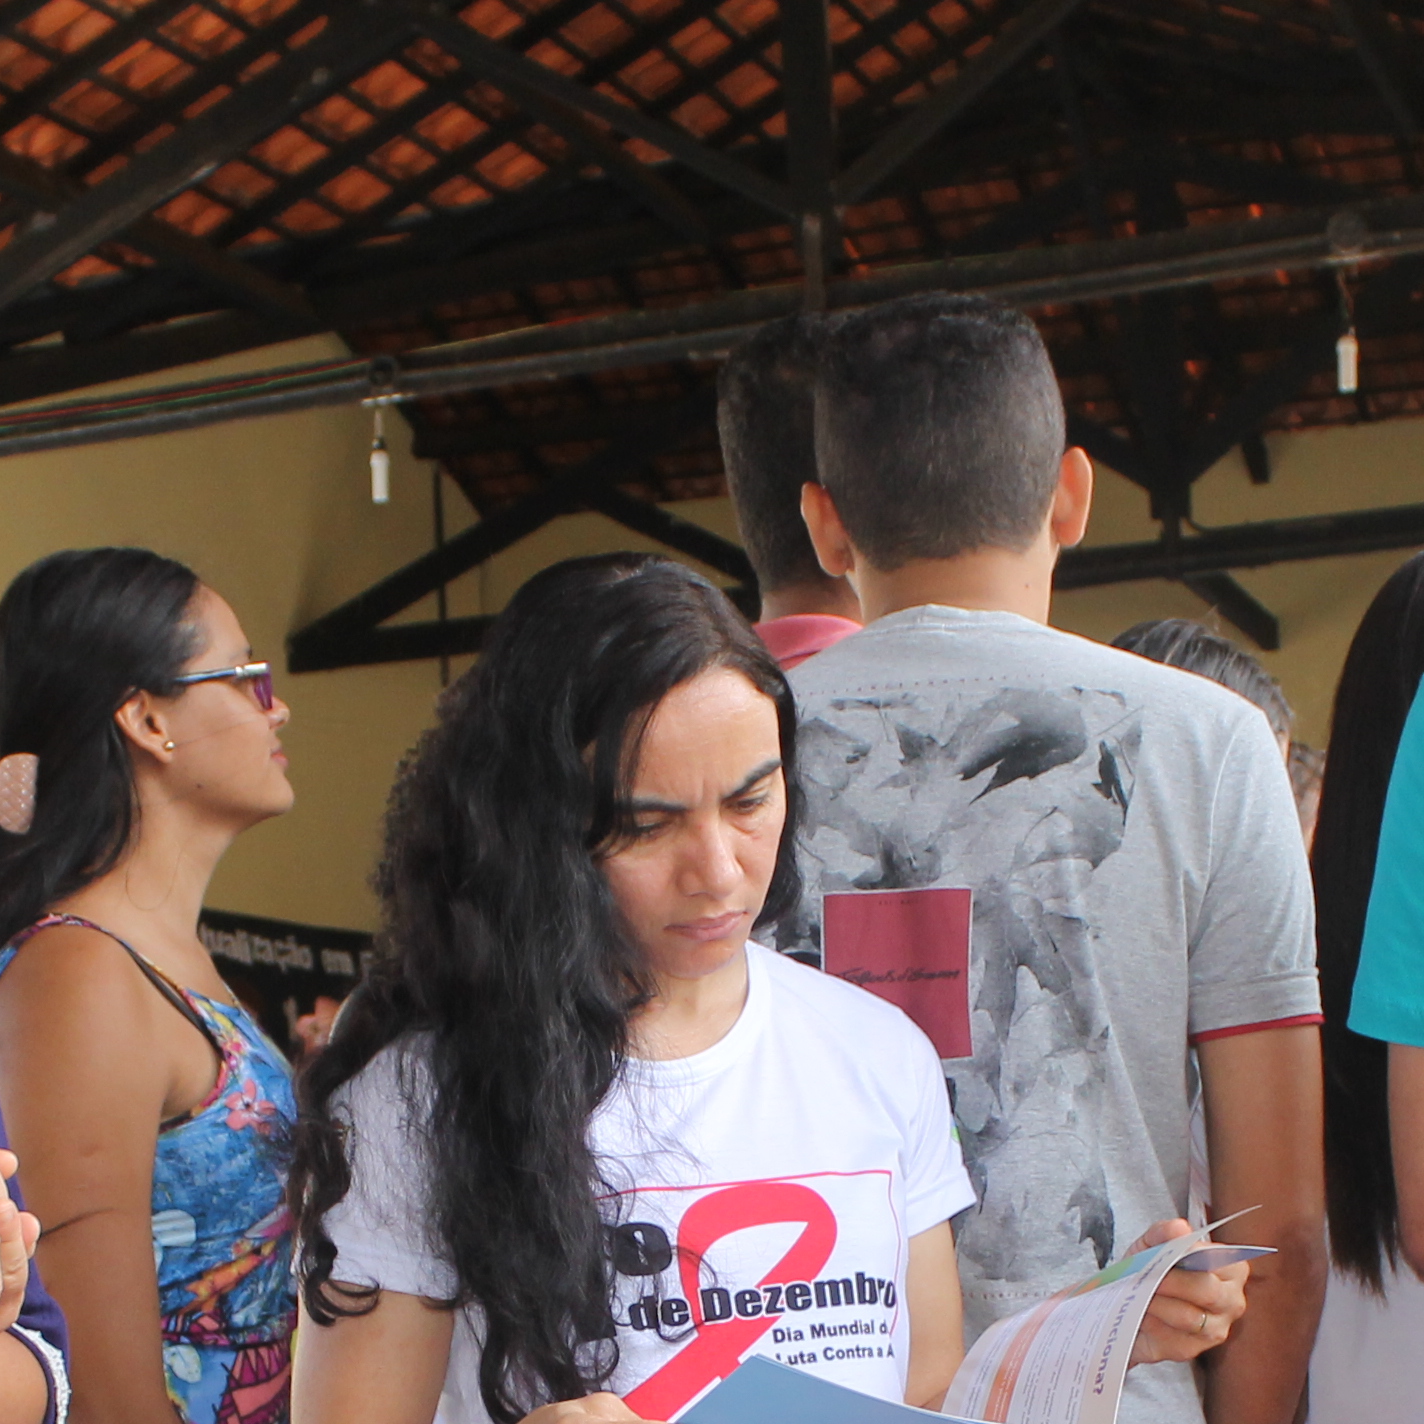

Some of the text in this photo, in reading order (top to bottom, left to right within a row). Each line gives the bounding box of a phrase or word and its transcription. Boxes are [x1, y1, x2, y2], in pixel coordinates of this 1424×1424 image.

[628, 1294, 689, 1331] de
[701, 1272, 896, 1323] Dezembro
[772, 1327, 804, 1344] Dia
[810, 1319, 874, 1339] Mundial
[822, 1344, 874, 1361] Contra
